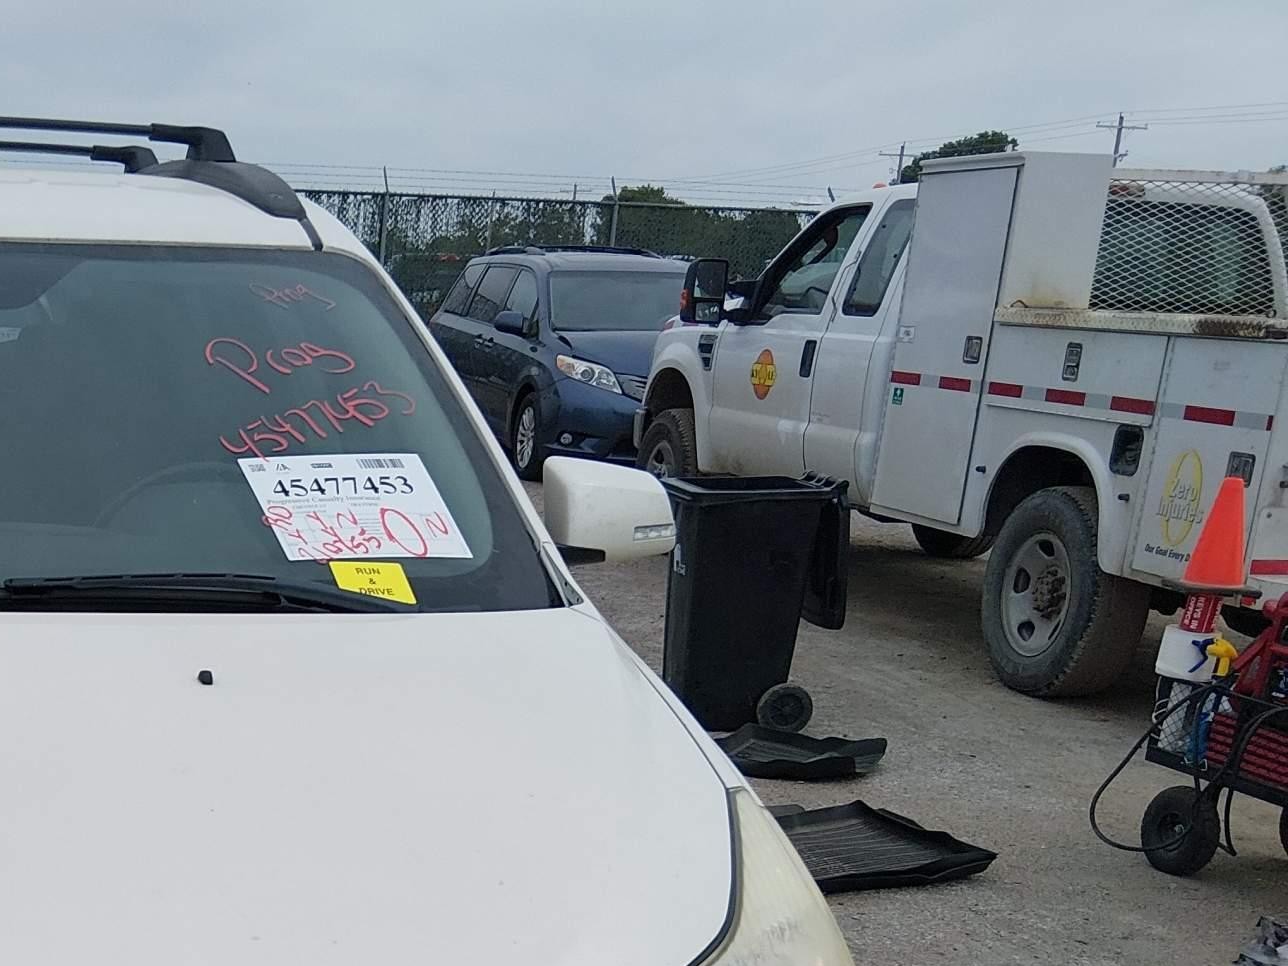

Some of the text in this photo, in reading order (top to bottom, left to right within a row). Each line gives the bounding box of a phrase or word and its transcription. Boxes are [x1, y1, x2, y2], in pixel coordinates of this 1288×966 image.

[219, 380, 416, 462] 45477453
[273, 476, 414, 497] 45477453
[1169, 478, 1199, 502] Zero
[1156, 496, 1205, 525] Injuries
[1144, 543, 1155, 553] Our
[1155, 546, 1169, 557] Goal
[355, 567, 381, 575] RUN
[358, 587, 395, 597] DRIVE
[1190, 597, 1207, 630] KEYS IN
